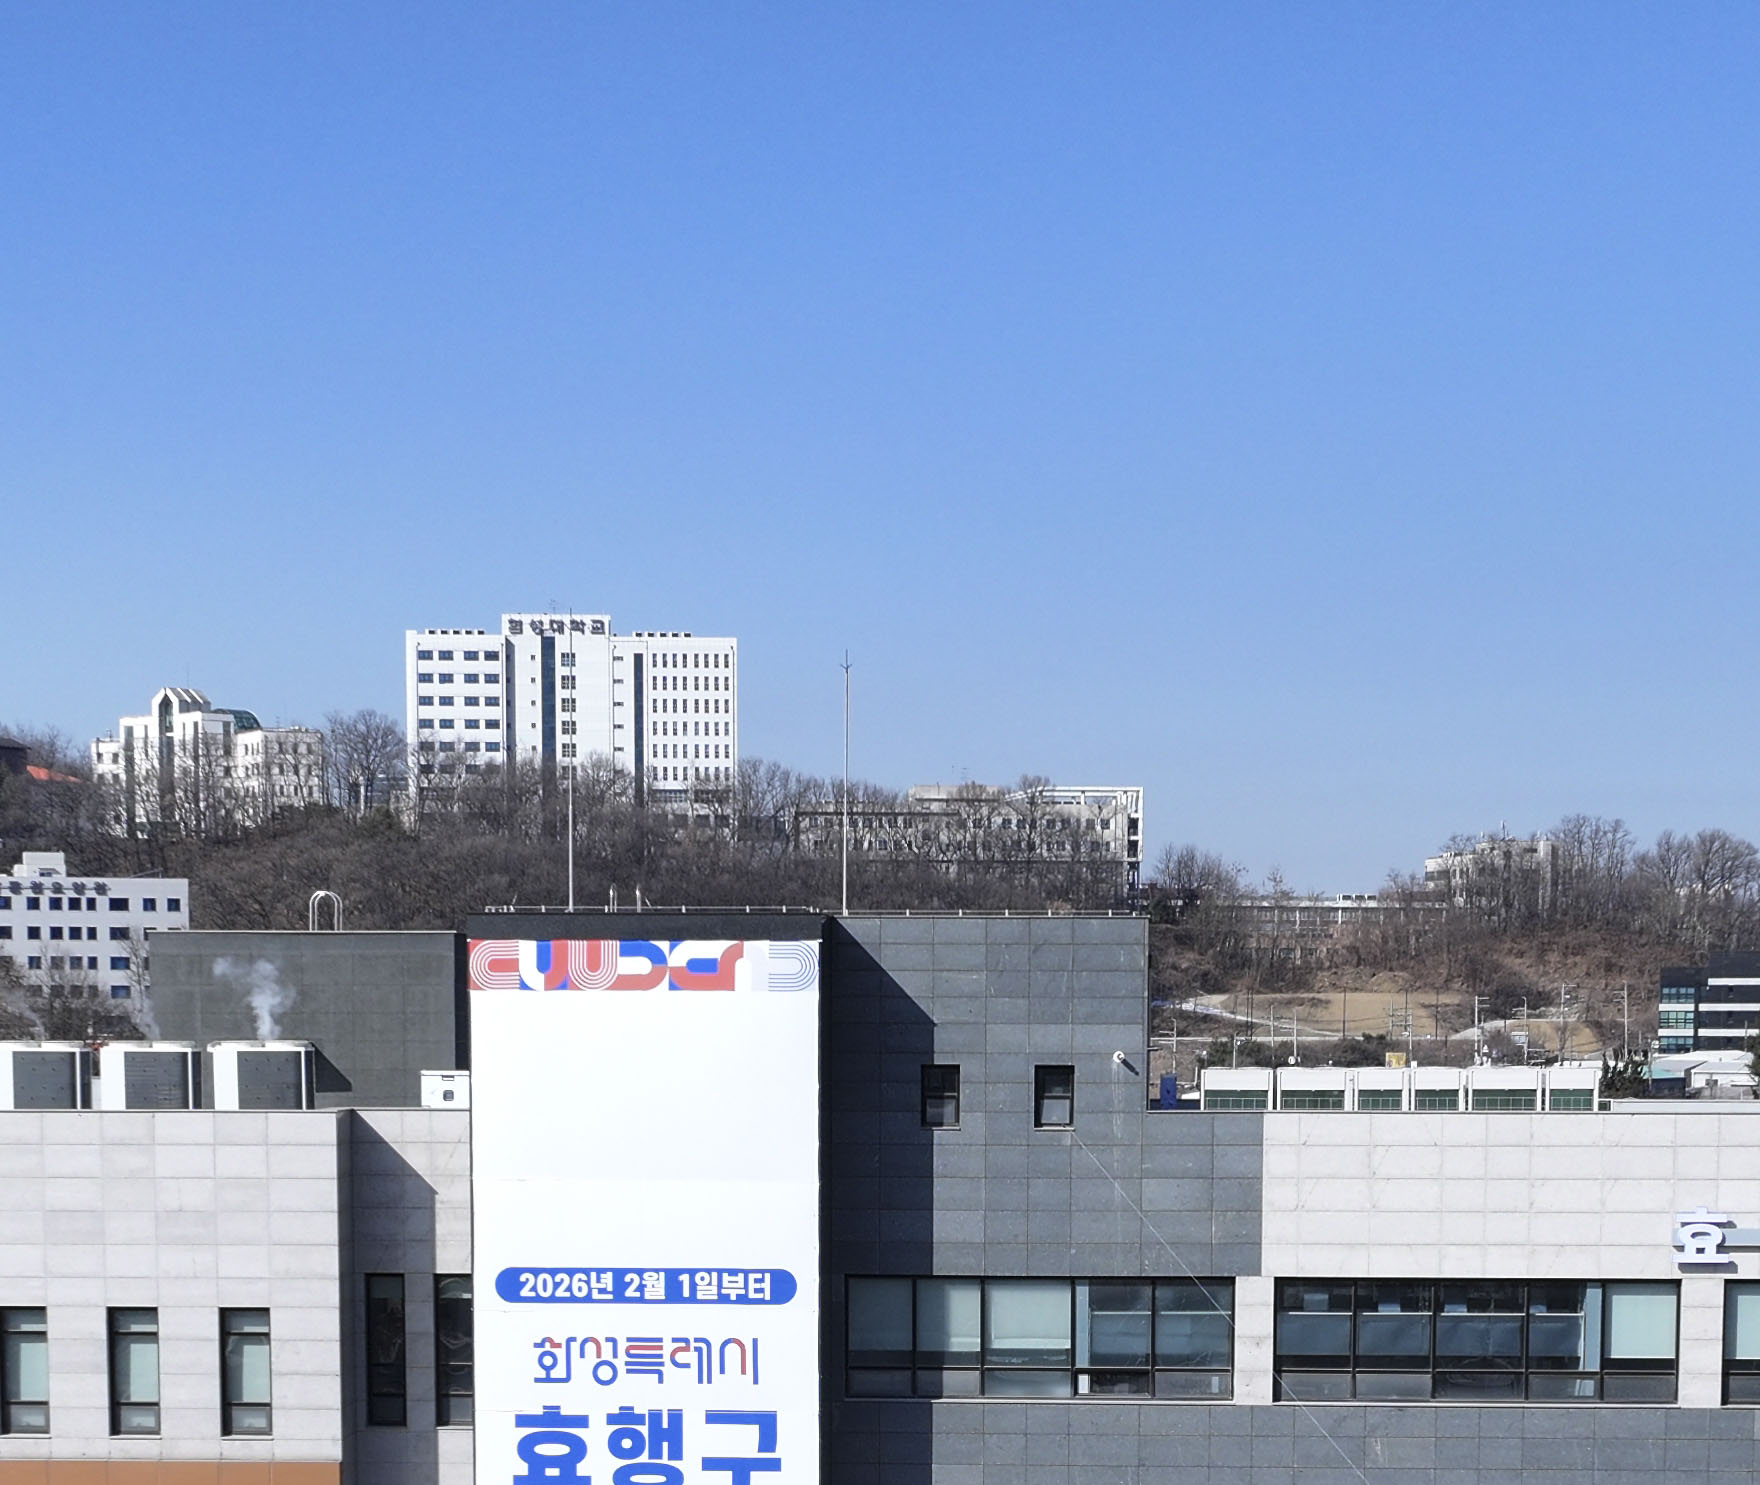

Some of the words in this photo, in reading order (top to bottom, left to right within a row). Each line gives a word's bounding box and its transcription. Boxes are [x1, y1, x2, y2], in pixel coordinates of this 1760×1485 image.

[519, 1271, 614, 1300] 2026년
[623, 1271, 666, 1300] 2월
[678, 1271, 772, 1301] 1일부터
[533, 1336, 760, 1386] 화성특례시
